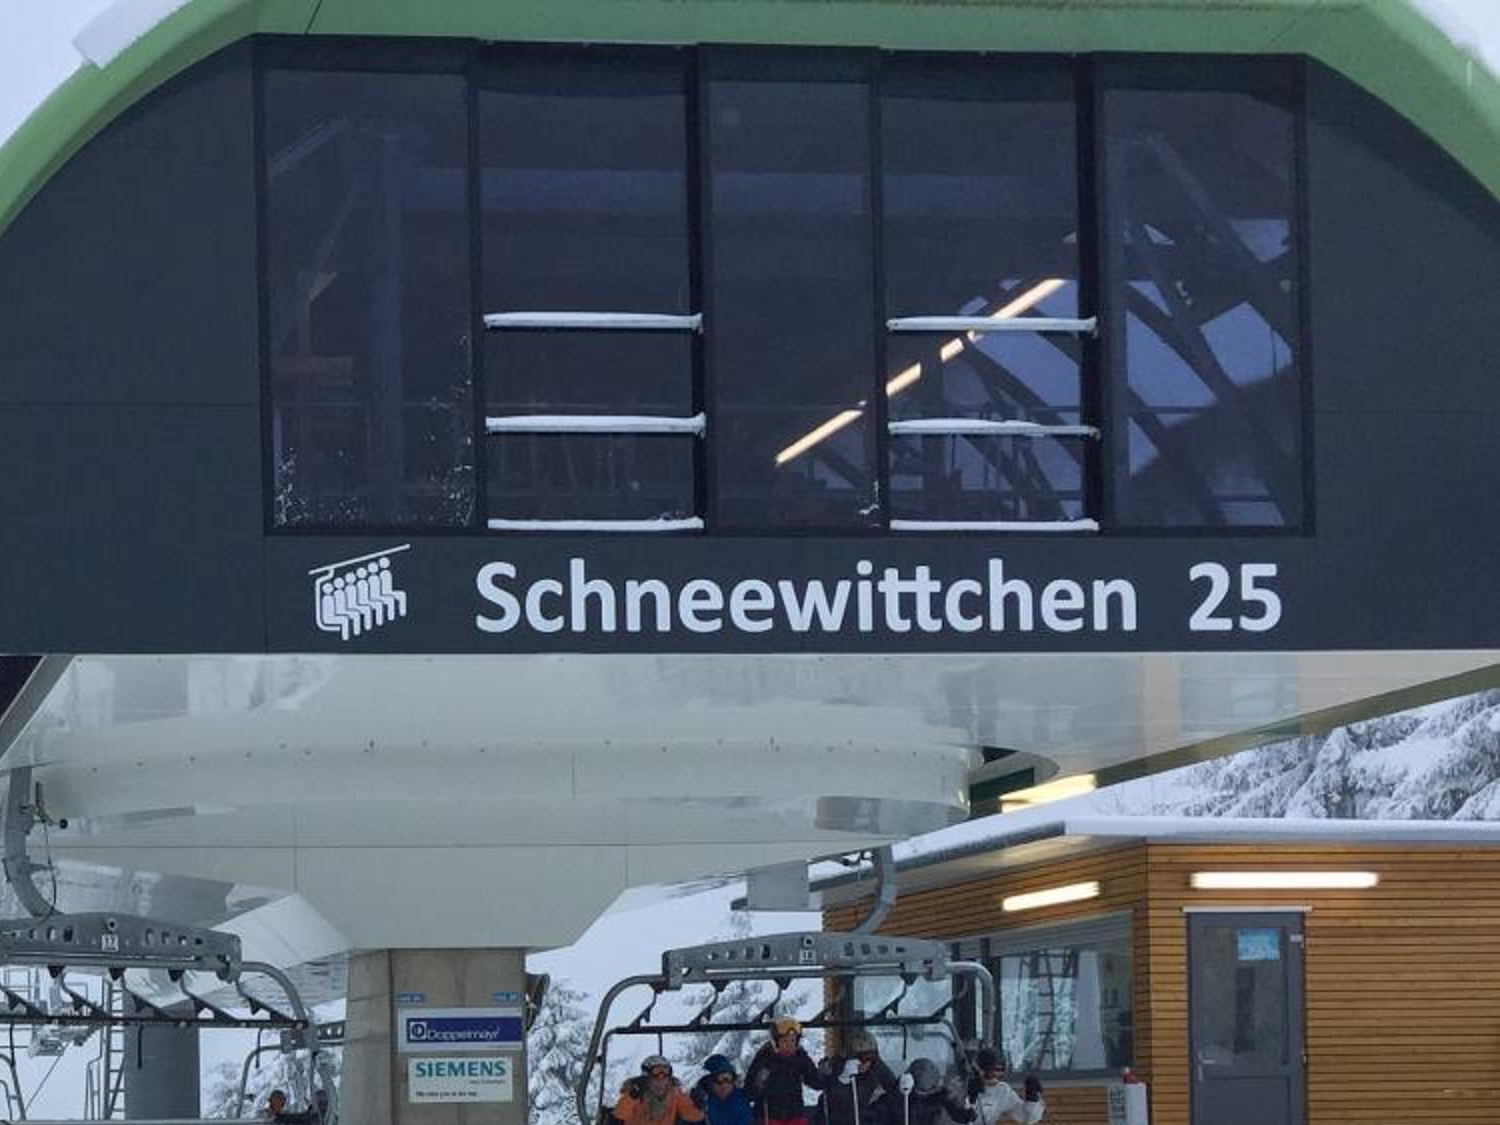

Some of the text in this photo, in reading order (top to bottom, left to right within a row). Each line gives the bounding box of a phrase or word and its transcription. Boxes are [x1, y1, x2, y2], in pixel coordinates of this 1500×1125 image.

[476, 557, 1282, 633] Schneewittchen 25
[416, 1060, 506, 1078] SIEMENS
